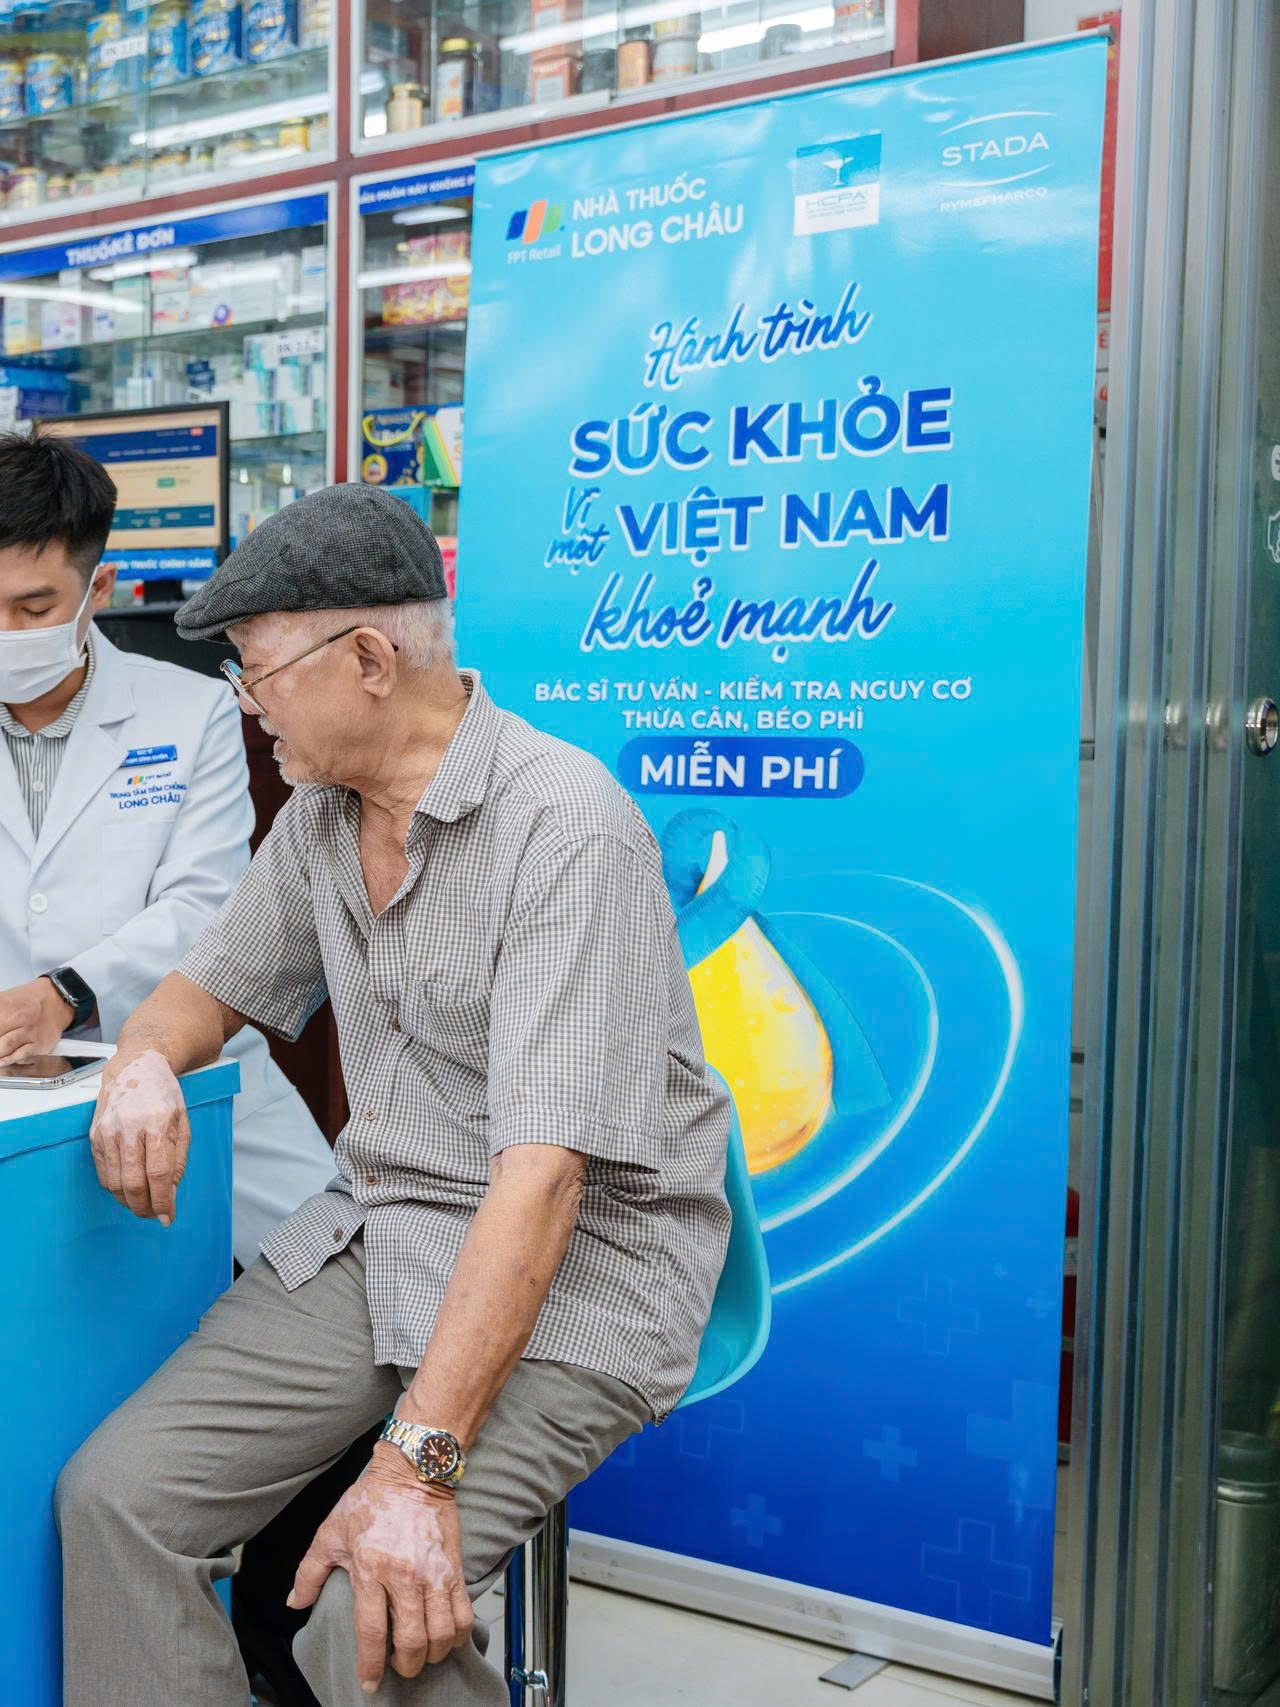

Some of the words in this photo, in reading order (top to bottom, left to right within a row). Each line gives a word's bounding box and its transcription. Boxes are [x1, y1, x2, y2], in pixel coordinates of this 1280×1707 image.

[941, 131, 1050, 167] STADA
[572, 188, 619, 221] NHÀ
[626, 171, 708, 211] THUỐC
[136, 226, 175, 251] ĐƠN
[507, 249, 526, 265] FPT
[529, 244, 561, 262] Retail
[571, 221, 654, 259] LONG
[660, 200, 745, 245] CHÂU
[761, 281, 871, 363] trình
[568, 401, 713, 478] SỨC
[729, 375, 953, 466] KHỎE
[562, 486, 601, 535] Vì
[616, 486, 766, 567] VIỆT
[780, 482, 950, 549] NAM
[544, 523, 610, 576] một
[580, 570, 715, 653] khoẻ
[716, 558, 897, 664] mạnh
[535, 678, 581, 701] BÁC
[586, 677, 609, 701] SĨ
[614, 680, 646, 701] TƯ
[649, 675, 698, 700] VẤN
[719, 673, 783, 701] KIỂM
[790, 679, 842, 701] TRA
[850, 679, 925, 701] NGUY
[931, 676, 972, 701] CƠ
[622, 704, 686, 729] THỪA
[691, 704, 749, 732] CÂN,
[756, 705, 813, 730] BÉO
[819, 705, 864, 730] PHÌ
[640, 740, 746, 789] MIỄN
[761, 748, 843, 790] PHÍ
[119, 797, 149, 810] LONG
[151, 791, 181, 805] CHÂU
